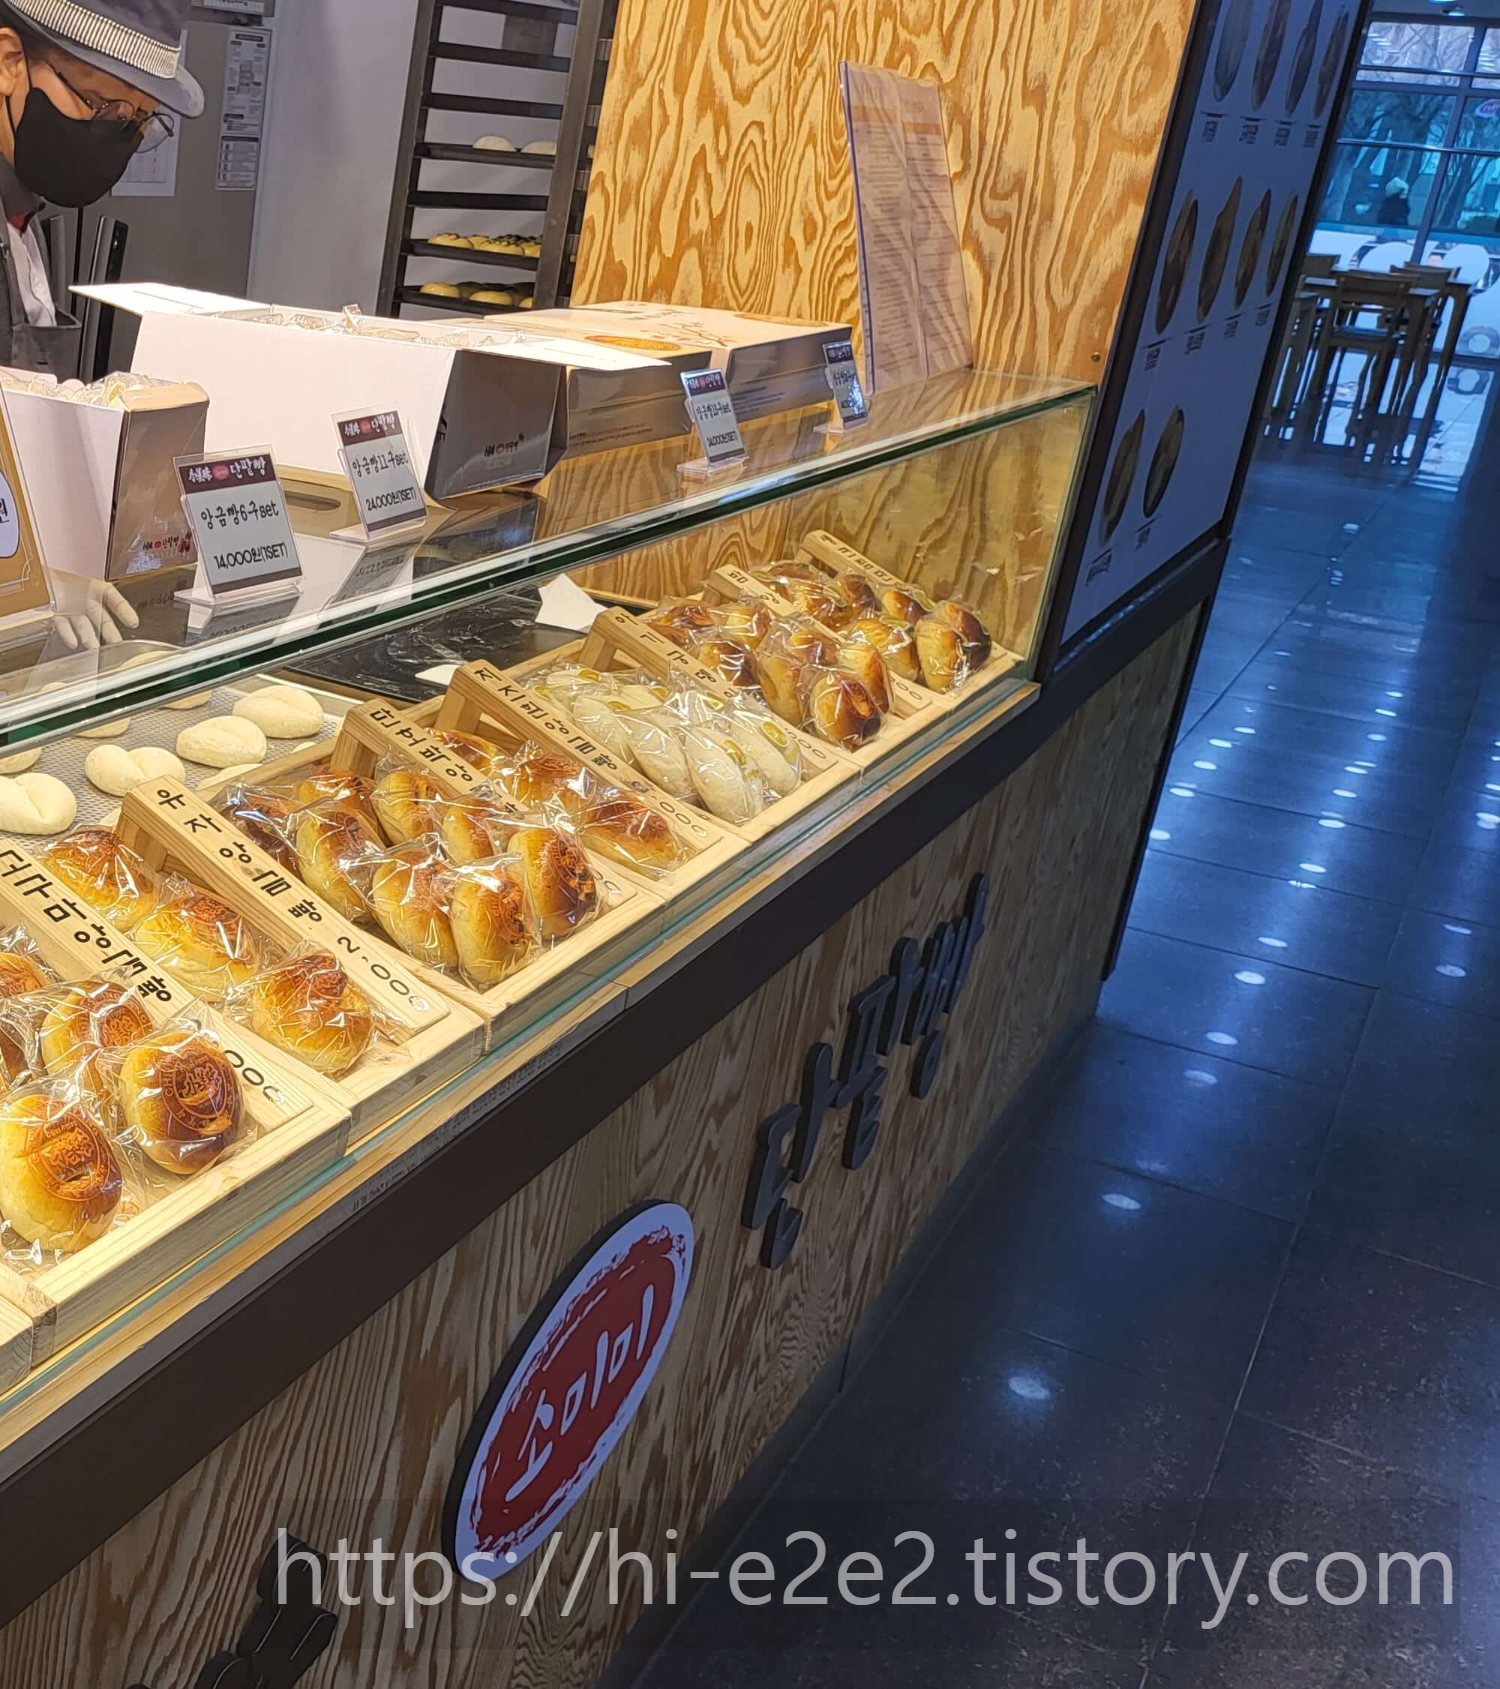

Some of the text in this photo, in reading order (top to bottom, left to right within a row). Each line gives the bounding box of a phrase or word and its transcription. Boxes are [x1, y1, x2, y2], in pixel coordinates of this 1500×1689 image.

[371, 412, 396, 433] 단팥빵
[228, 456, 267, 481] 단팥빵
[200, 499, 280, 530] 앙금빵6구set
[213, 541, 288, 570] 14,000원(1SET)
[369, 707, 521, 814] 단호박앙
[155, 788, 430, 1013] 유자앙금빵 2,000
[506, 872, 989, 1503] 소미미 단팥빵
